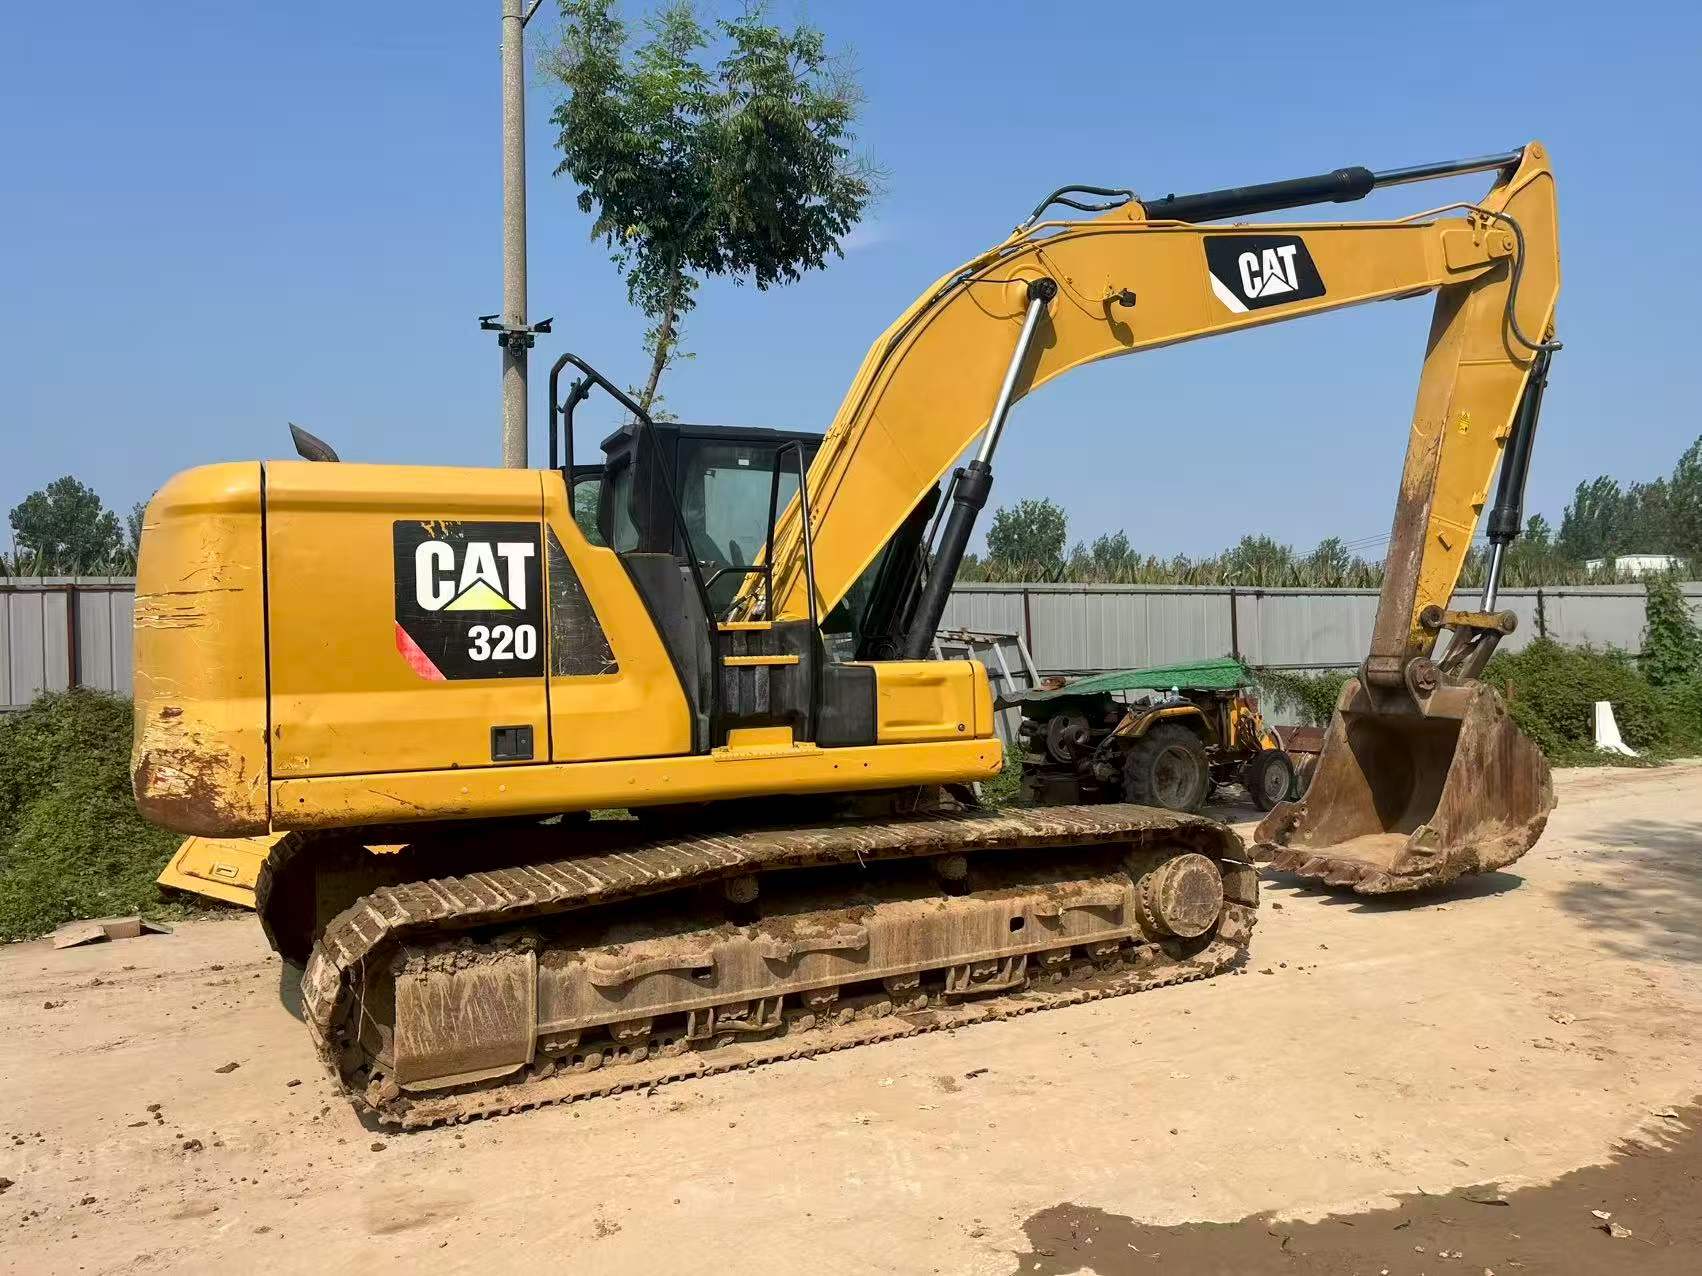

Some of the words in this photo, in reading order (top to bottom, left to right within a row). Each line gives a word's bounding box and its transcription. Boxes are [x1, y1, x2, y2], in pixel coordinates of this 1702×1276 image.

[1238, 244, 1299, 298] CAT
[415, 540, 535, 611] CAT
[468, 624, 537, 661] 320
